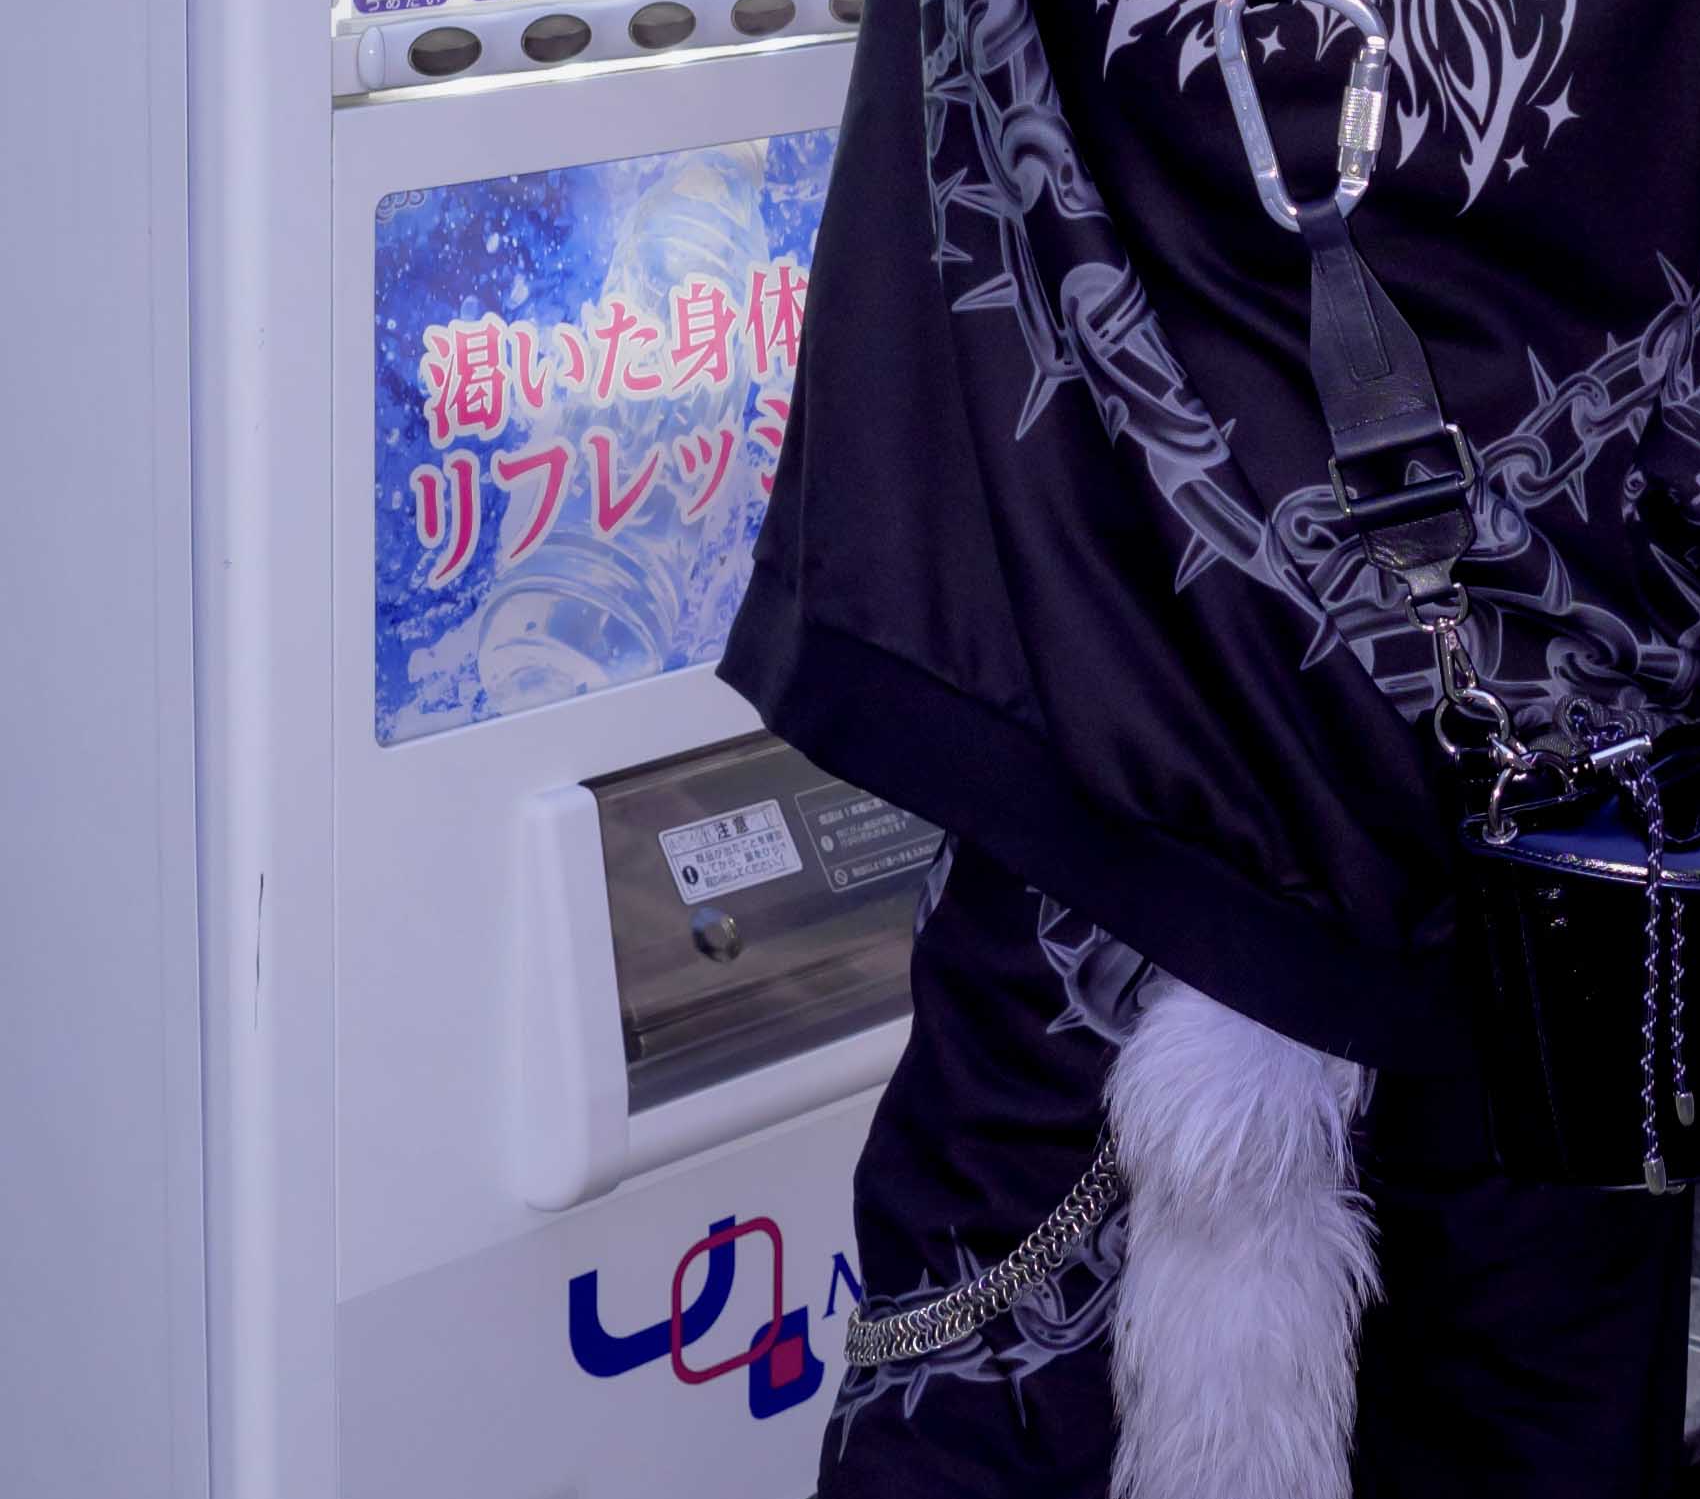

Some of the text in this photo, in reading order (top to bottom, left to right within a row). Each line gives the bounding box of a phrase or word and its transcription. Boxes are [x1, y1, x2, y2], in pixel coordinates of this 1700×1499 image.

[429, 266, 808, 439] 渇いた身体
[716, 816, 749, 840] 注意
